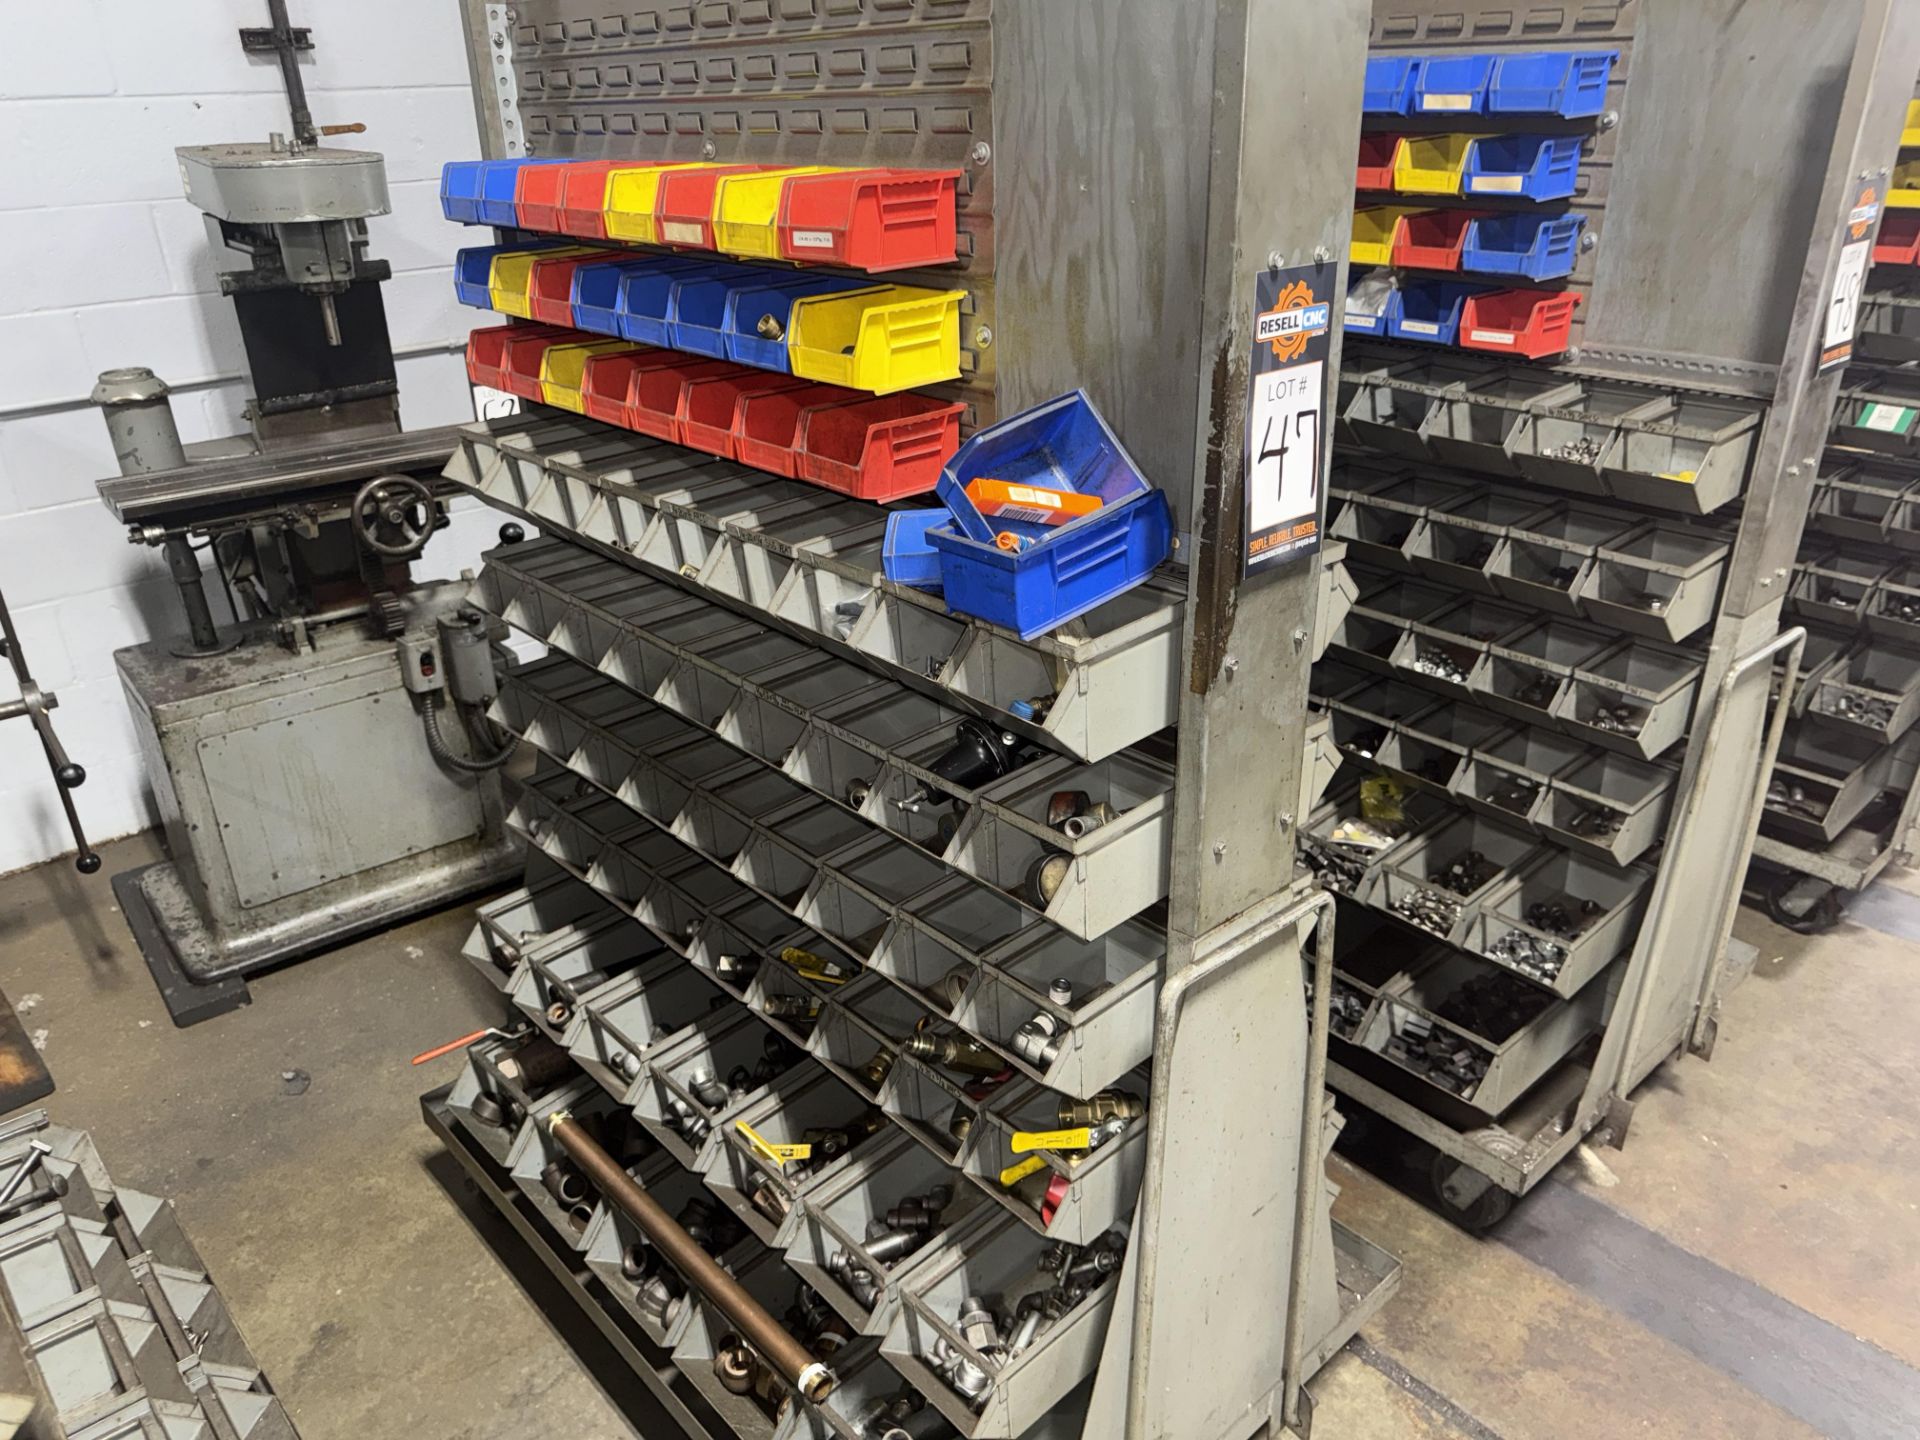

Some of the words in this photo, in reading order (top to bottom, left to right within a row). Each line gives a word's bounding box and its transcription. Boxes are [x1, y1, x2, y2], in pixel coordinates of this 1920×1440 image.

[1260, 315, 1299, 335] RESELL
[1303, 309, 1326, 327] CNC
[1268, 379, 1296, 402] LOT
[1257, 409, 1318, 502] 47
